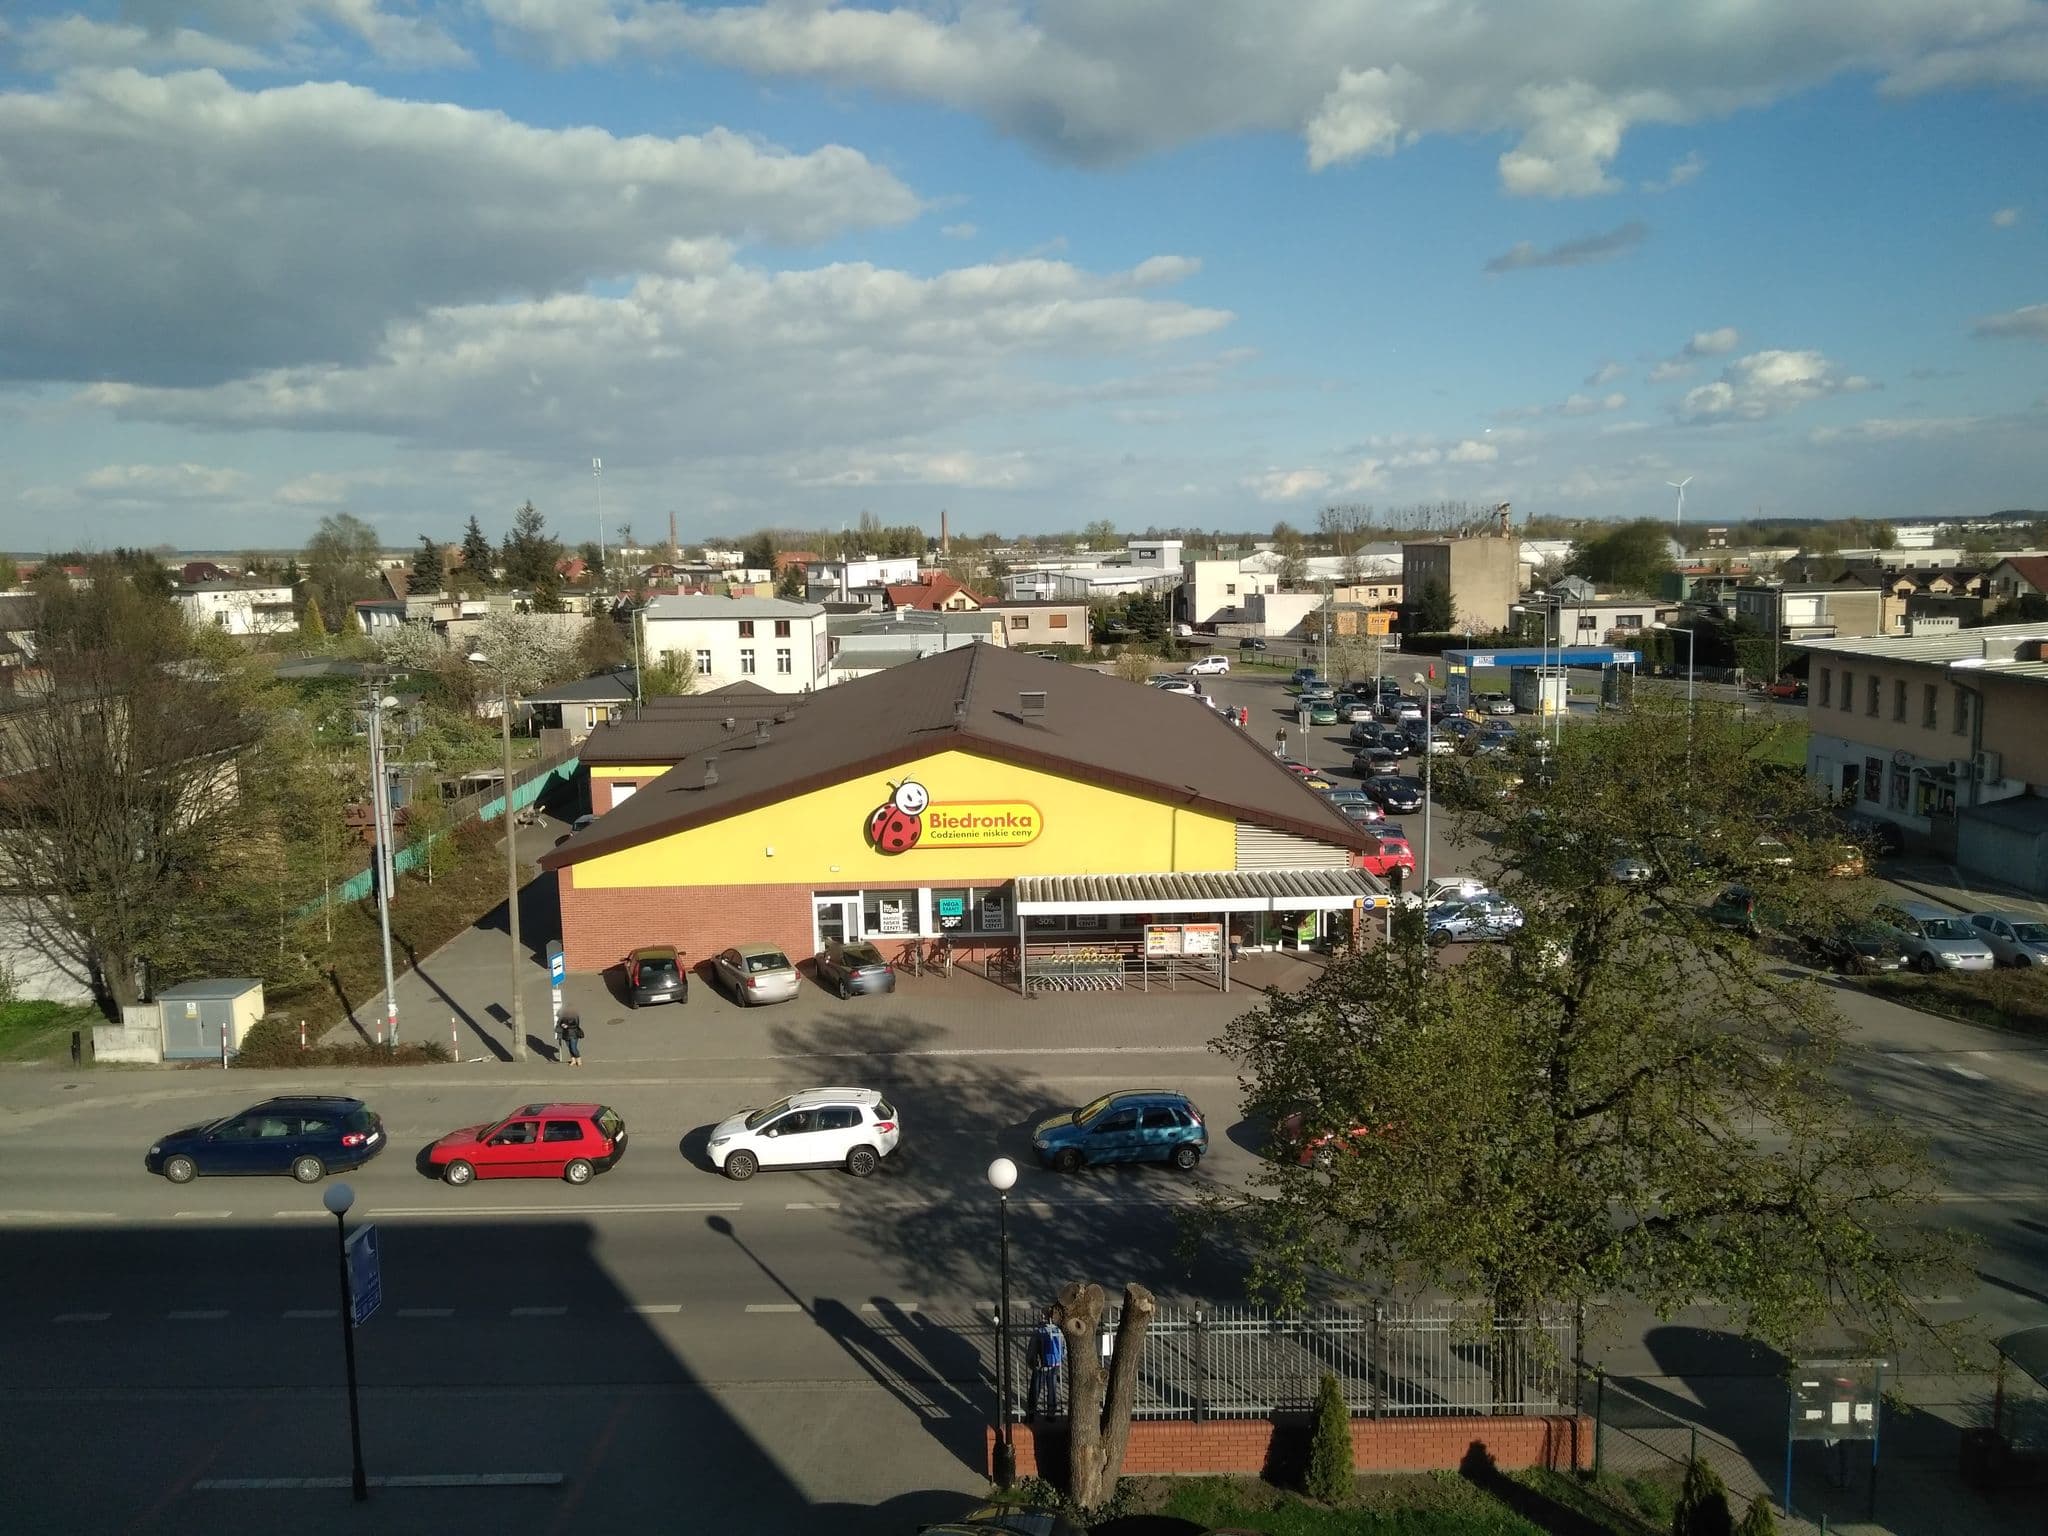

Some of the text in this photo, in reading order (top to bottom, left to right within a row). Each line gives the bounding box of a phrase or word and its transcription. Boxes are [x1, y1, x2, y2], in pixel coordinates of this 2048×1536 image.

[929, 812, 1032, 828] Biedronka
[930, 829, 1032, 839] Codziennie niskie ceny
[942, 920, 961, 928] -50%
